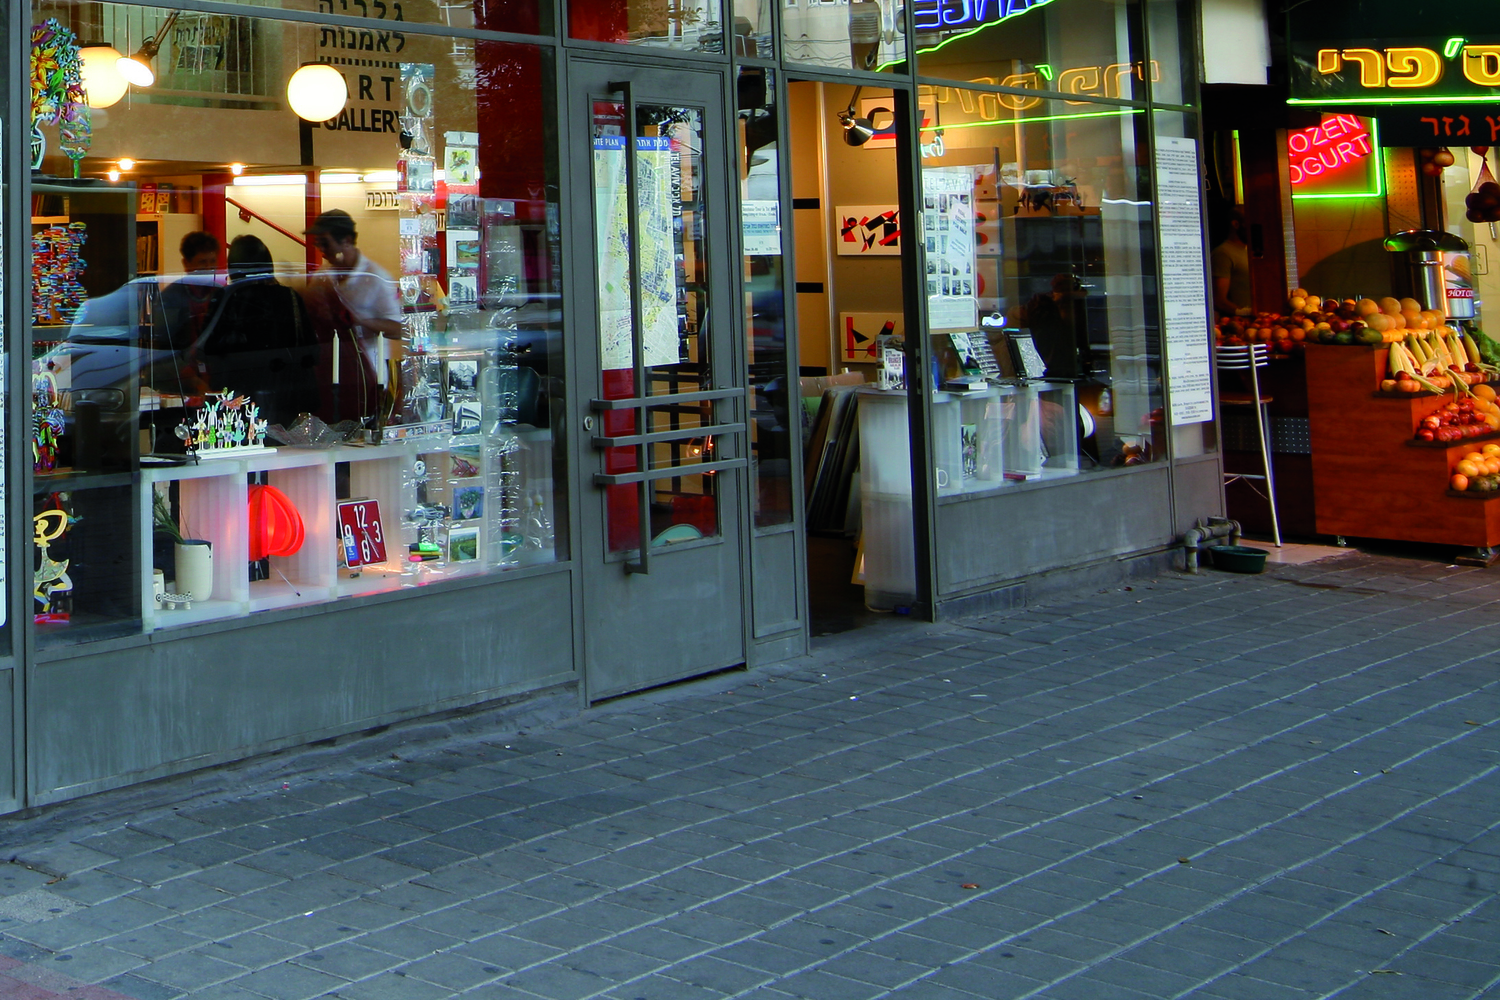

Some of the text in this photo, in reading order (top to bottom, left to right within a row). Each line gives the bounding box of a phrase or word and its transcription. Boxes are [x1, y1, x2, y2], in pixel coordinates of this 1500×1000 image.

[320, 24, 406, 53] לאמנות
[345, 74, 395, 102] RT
[1289, 114, 1363, 156] OZEN
[1420, 114, 1471, 136] גזר
[605, 138, 619, 146] PLAN
[671, 153, 681, 165] TEL
[353, 504, 368, 528] 12
[372, 521, 381, 543] 3
